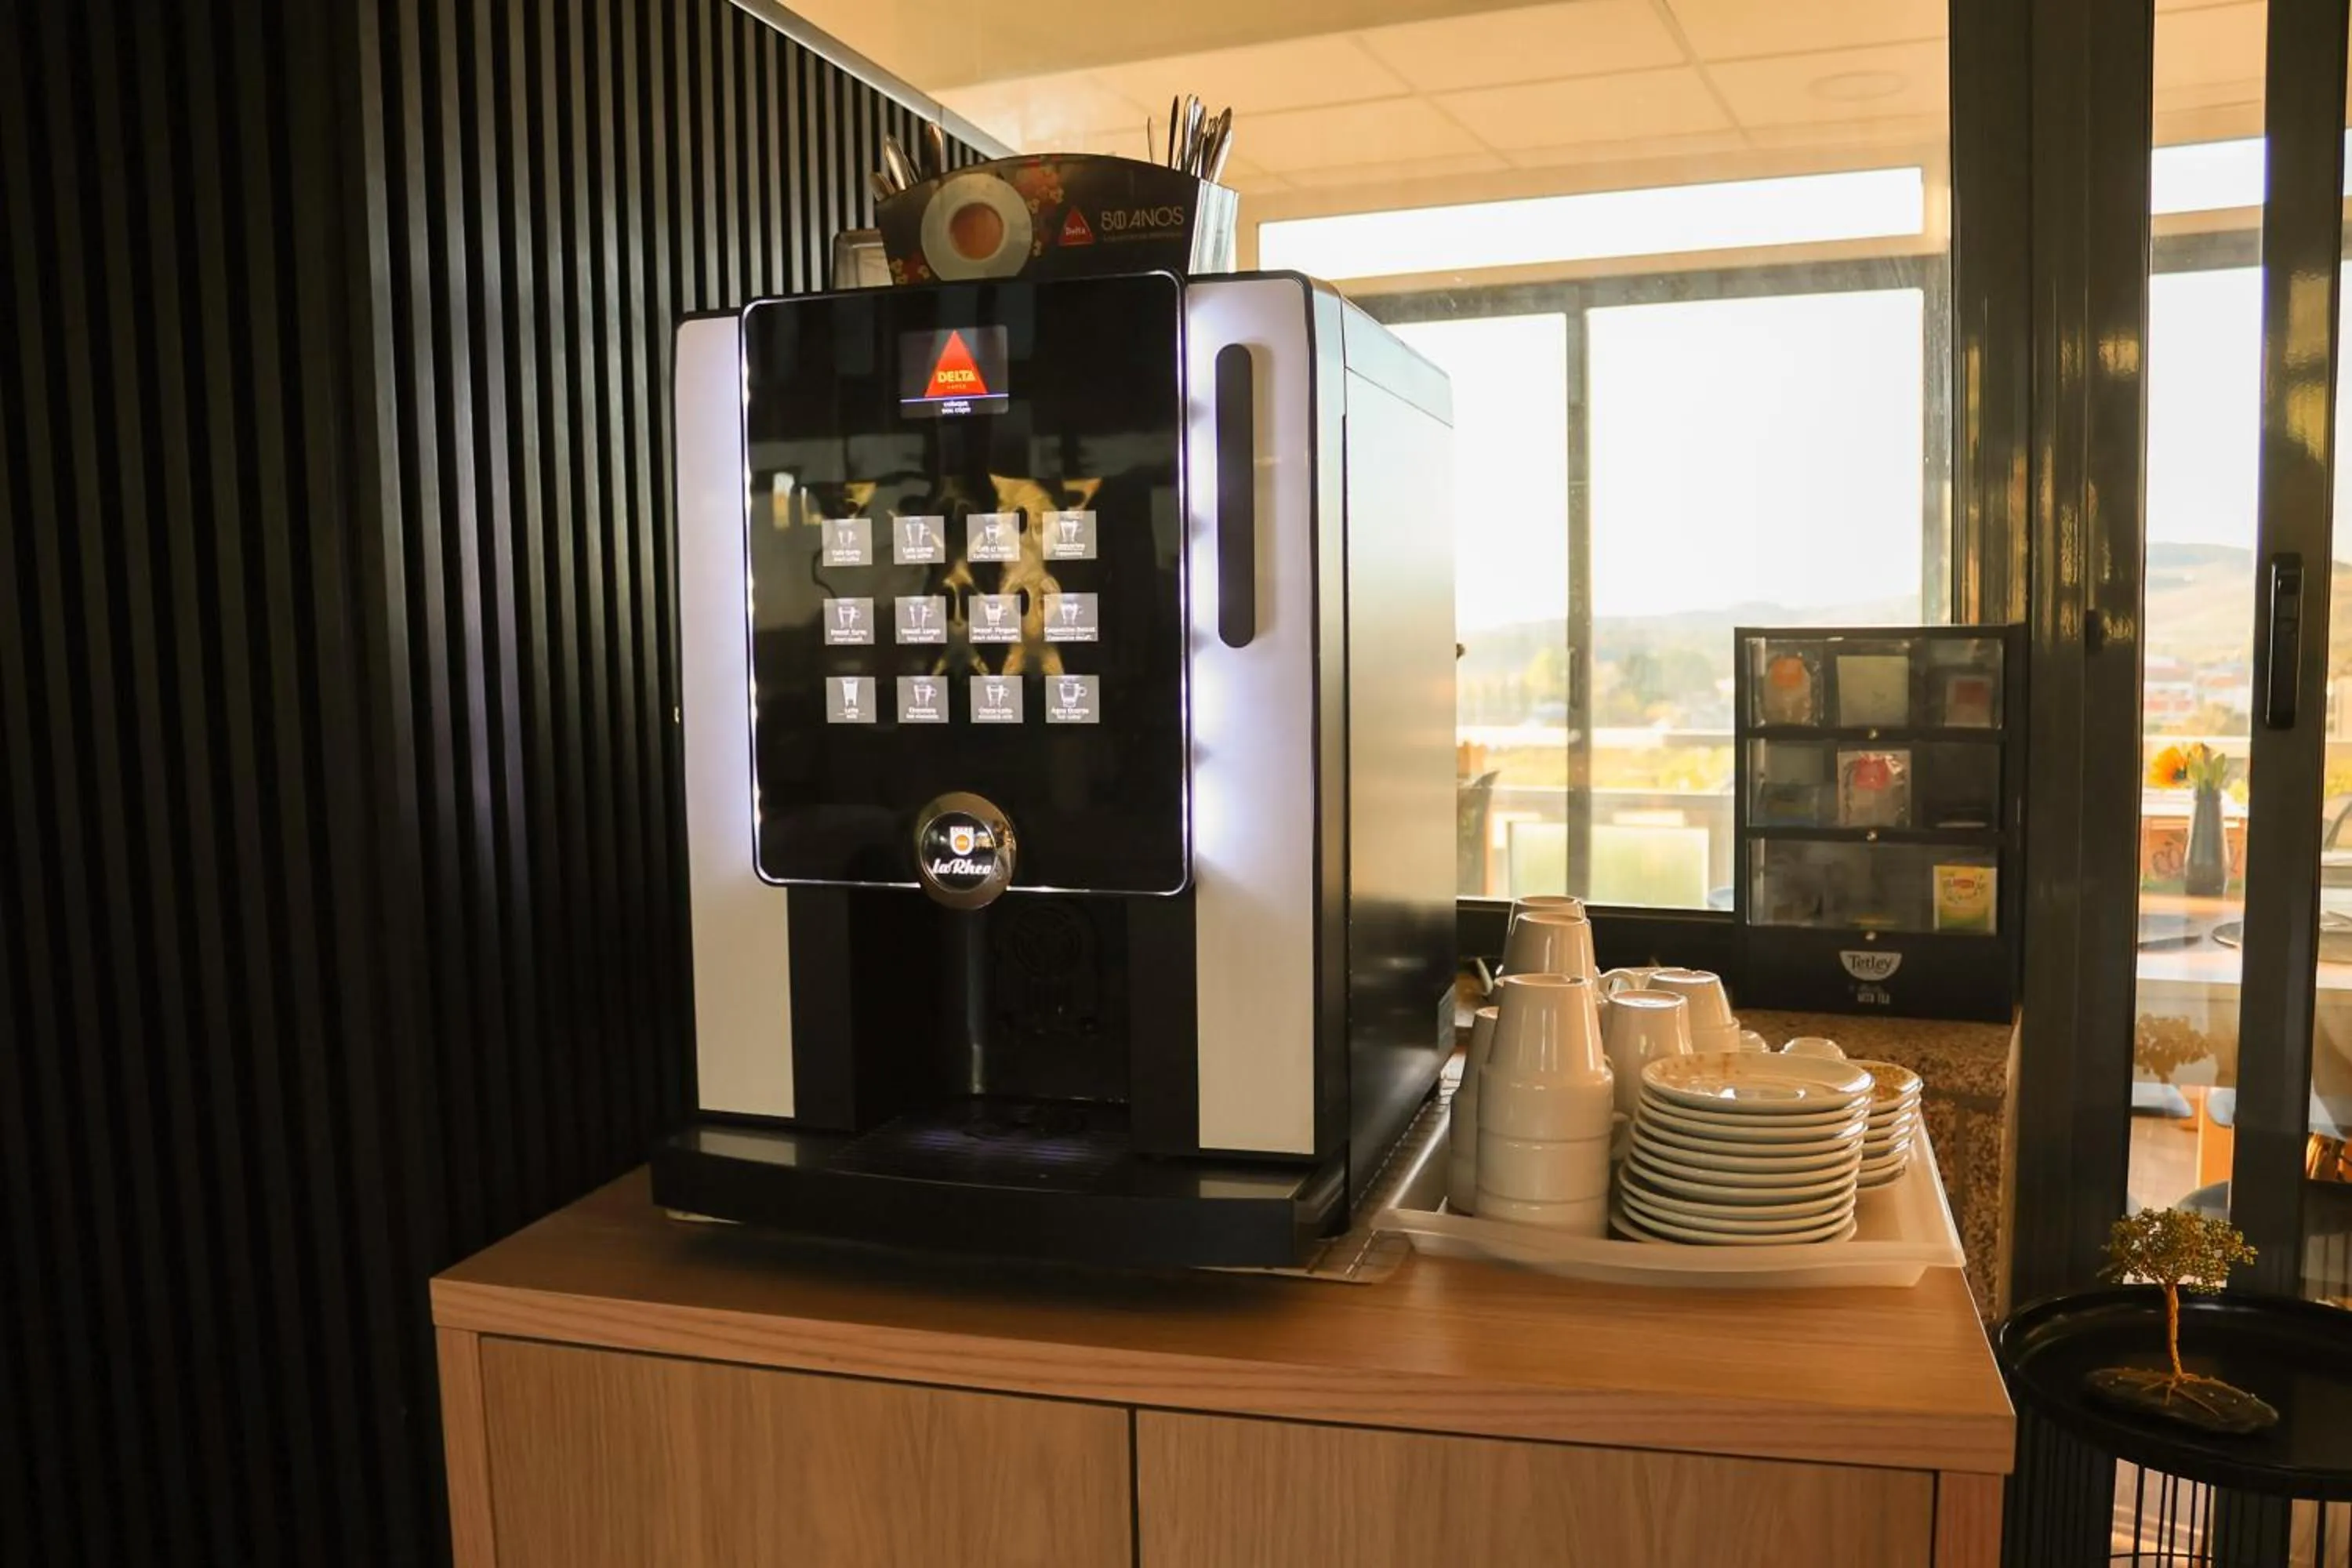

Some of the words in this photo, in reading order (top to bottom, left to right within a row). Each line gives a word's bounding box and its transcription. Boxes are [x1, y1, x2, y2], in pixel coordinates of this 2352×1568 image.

[1129, 205, 1185, 228] ANOS
[1065, 226, 1086, 235] Delta
[938, 369, 976, 383] DELTA
[1847, 954, 1894, 975] Tetley
